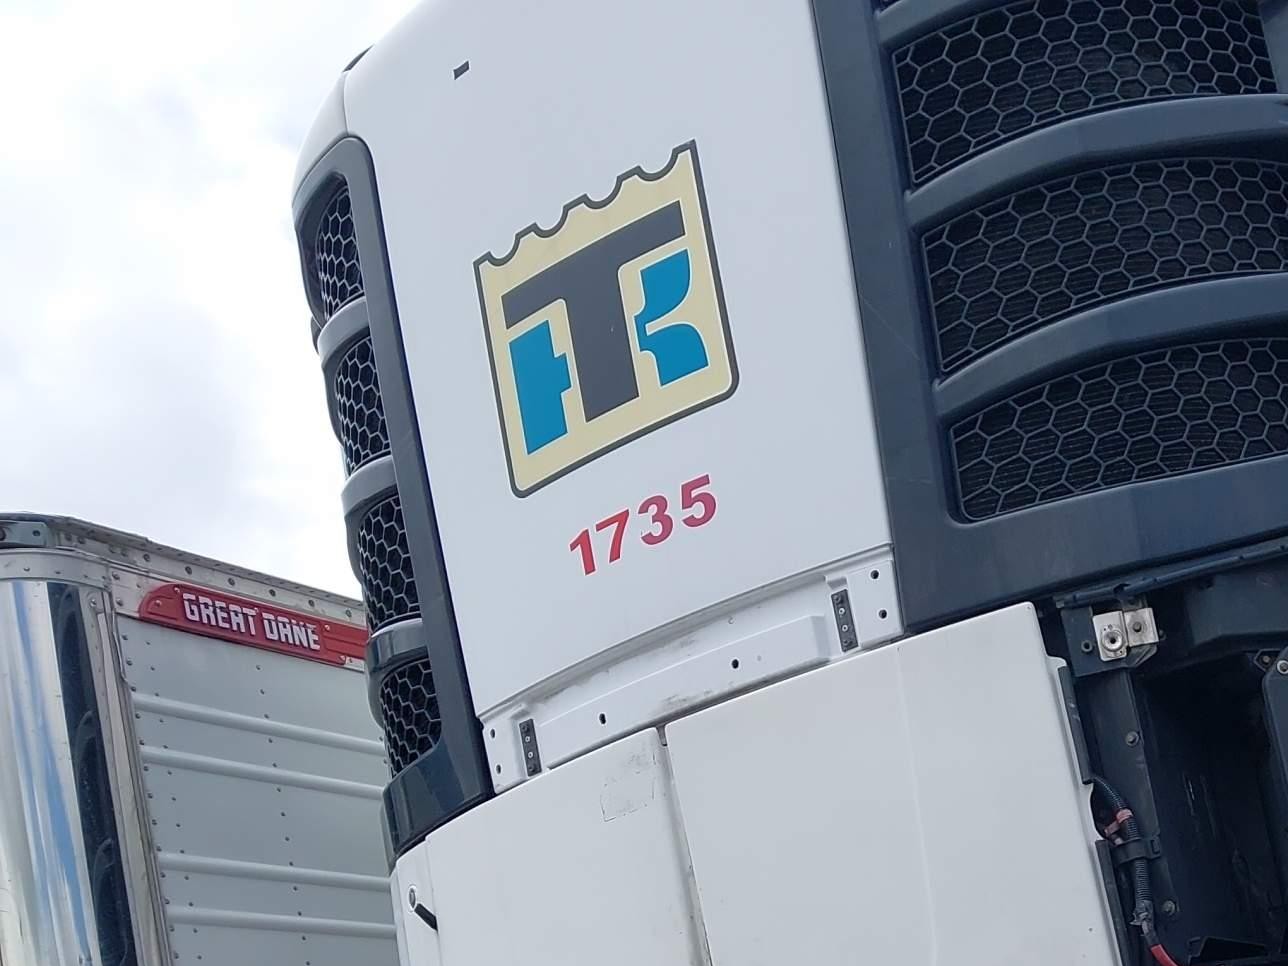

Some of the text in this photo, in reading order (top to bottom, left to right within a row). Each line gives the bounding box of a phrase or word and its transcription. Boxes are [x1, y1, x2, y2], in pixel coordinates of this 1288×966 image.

[569, 474, 718, 577] 1735
[182, 592, 321, 651] GREAT DANE
